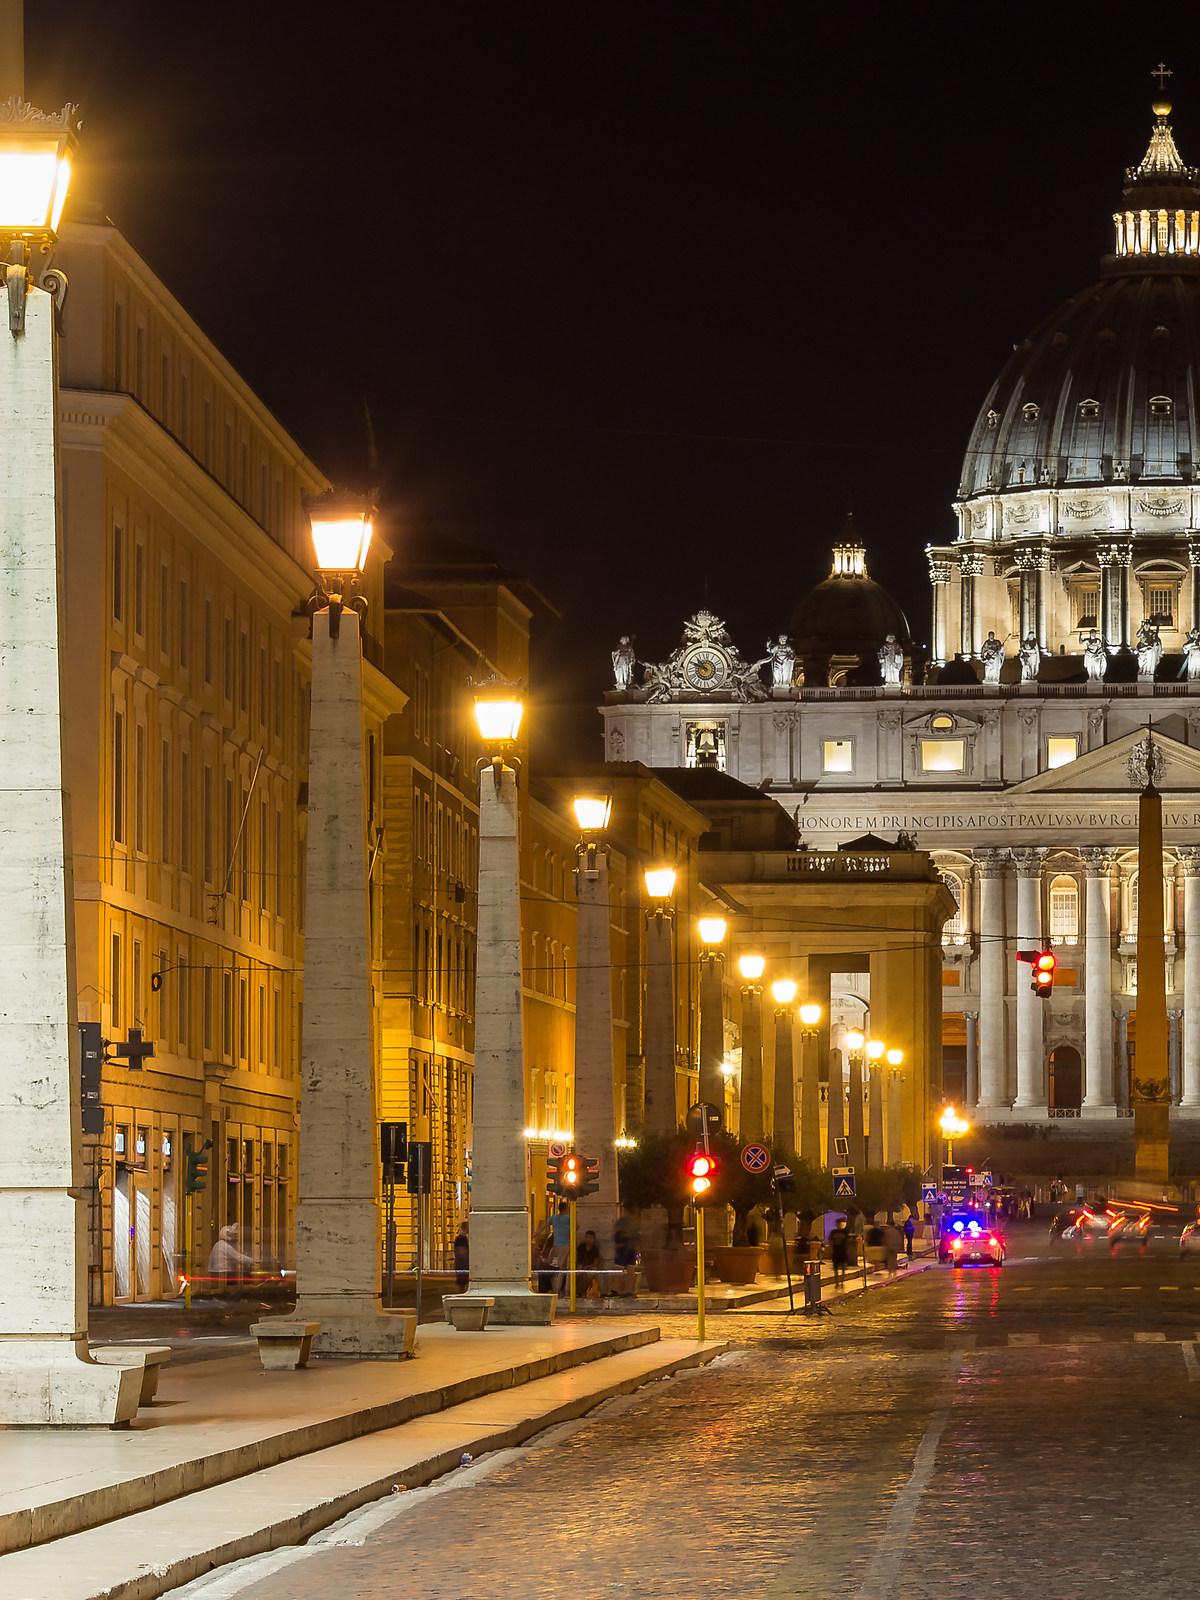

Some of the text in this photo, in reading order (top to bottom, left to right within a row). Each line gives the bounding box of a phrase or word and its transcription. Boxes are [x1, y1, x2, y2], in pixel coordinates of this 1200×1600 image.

[882, 815, 963, 828] PRINCIPIS
[967, 814, 1016, 827] APOST
[1019, 814, 1072, 826] PAVLVS
